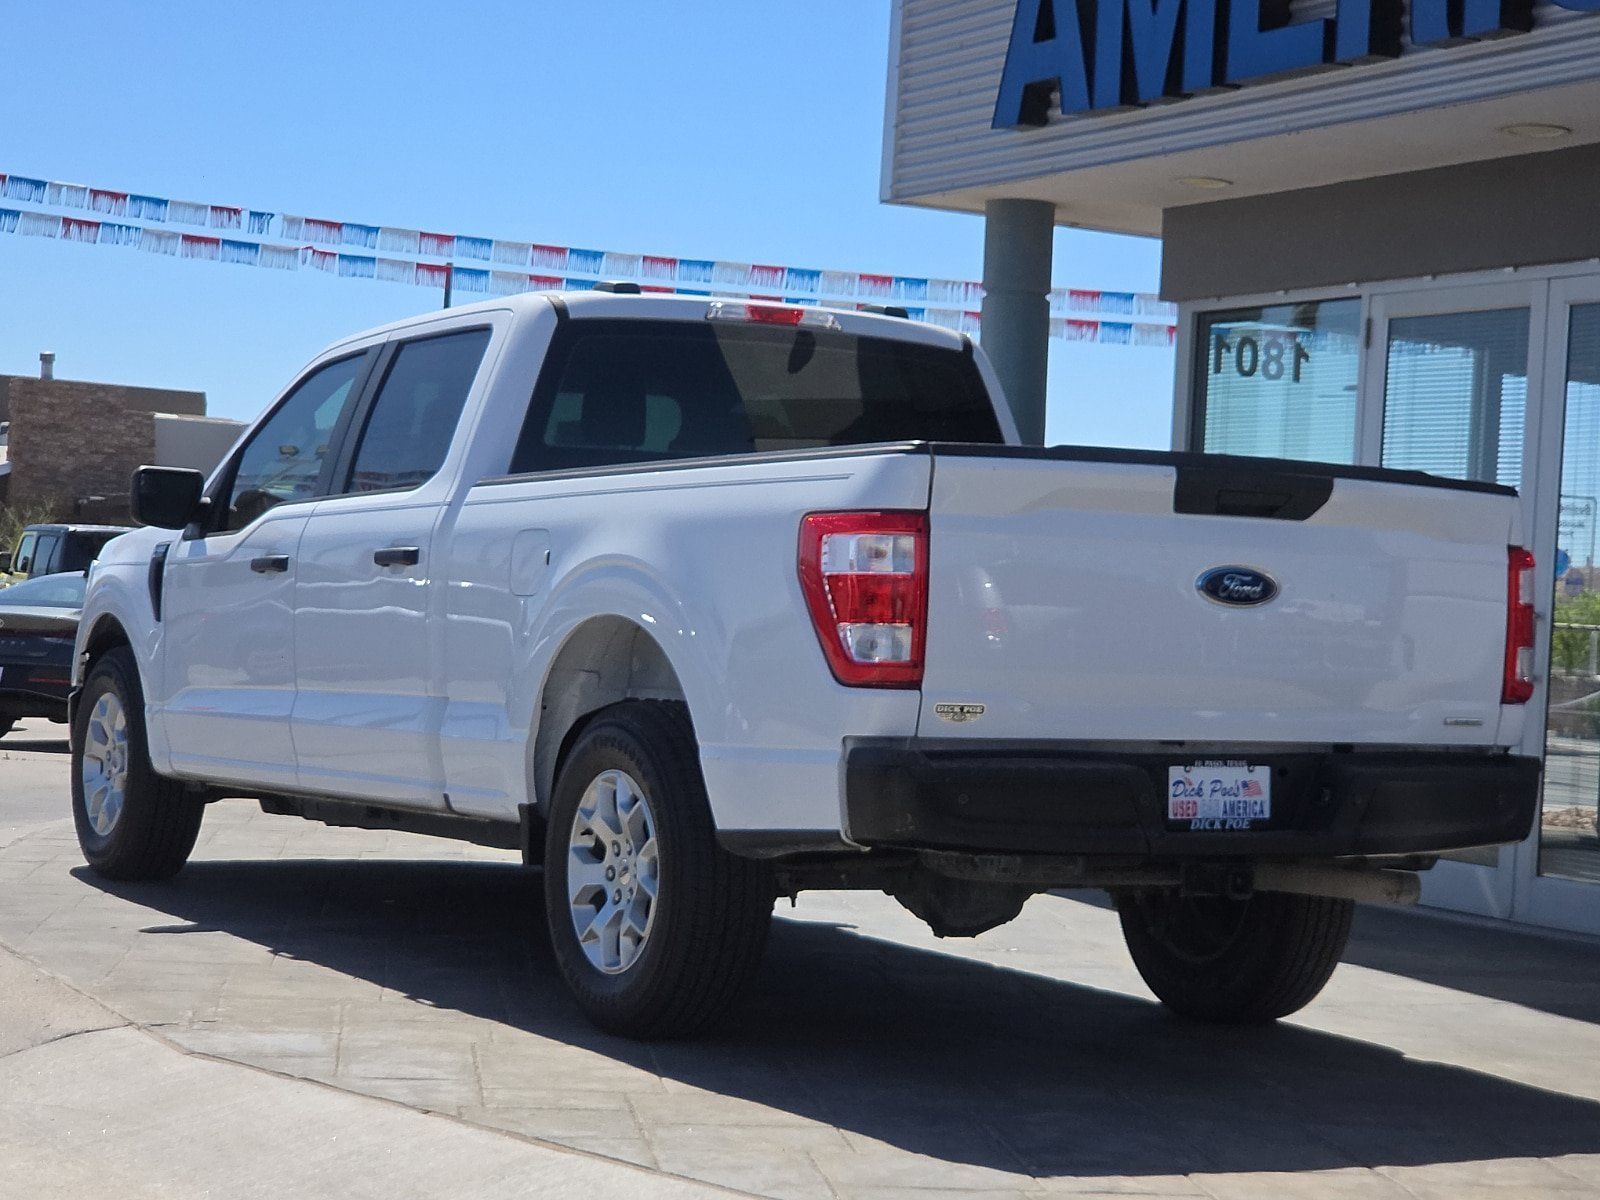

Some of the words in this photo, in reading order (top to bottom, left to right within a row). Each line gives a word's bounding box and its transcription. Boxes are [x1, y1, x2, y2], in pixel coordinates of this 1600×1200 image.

[1219, 573, 1264, 598] Ford
[964, 705, 983, 713] POE
[1172, 779, 1204, 798] Dick
[1209, 779, 1240, 798] Poe's
[1172, 800, 1198, 818] USED
[1221, 800, 1265, 817] AMERICA
[1190, 818, 1222, 830] DICK
[1225, 818, 1251, 829] POE
